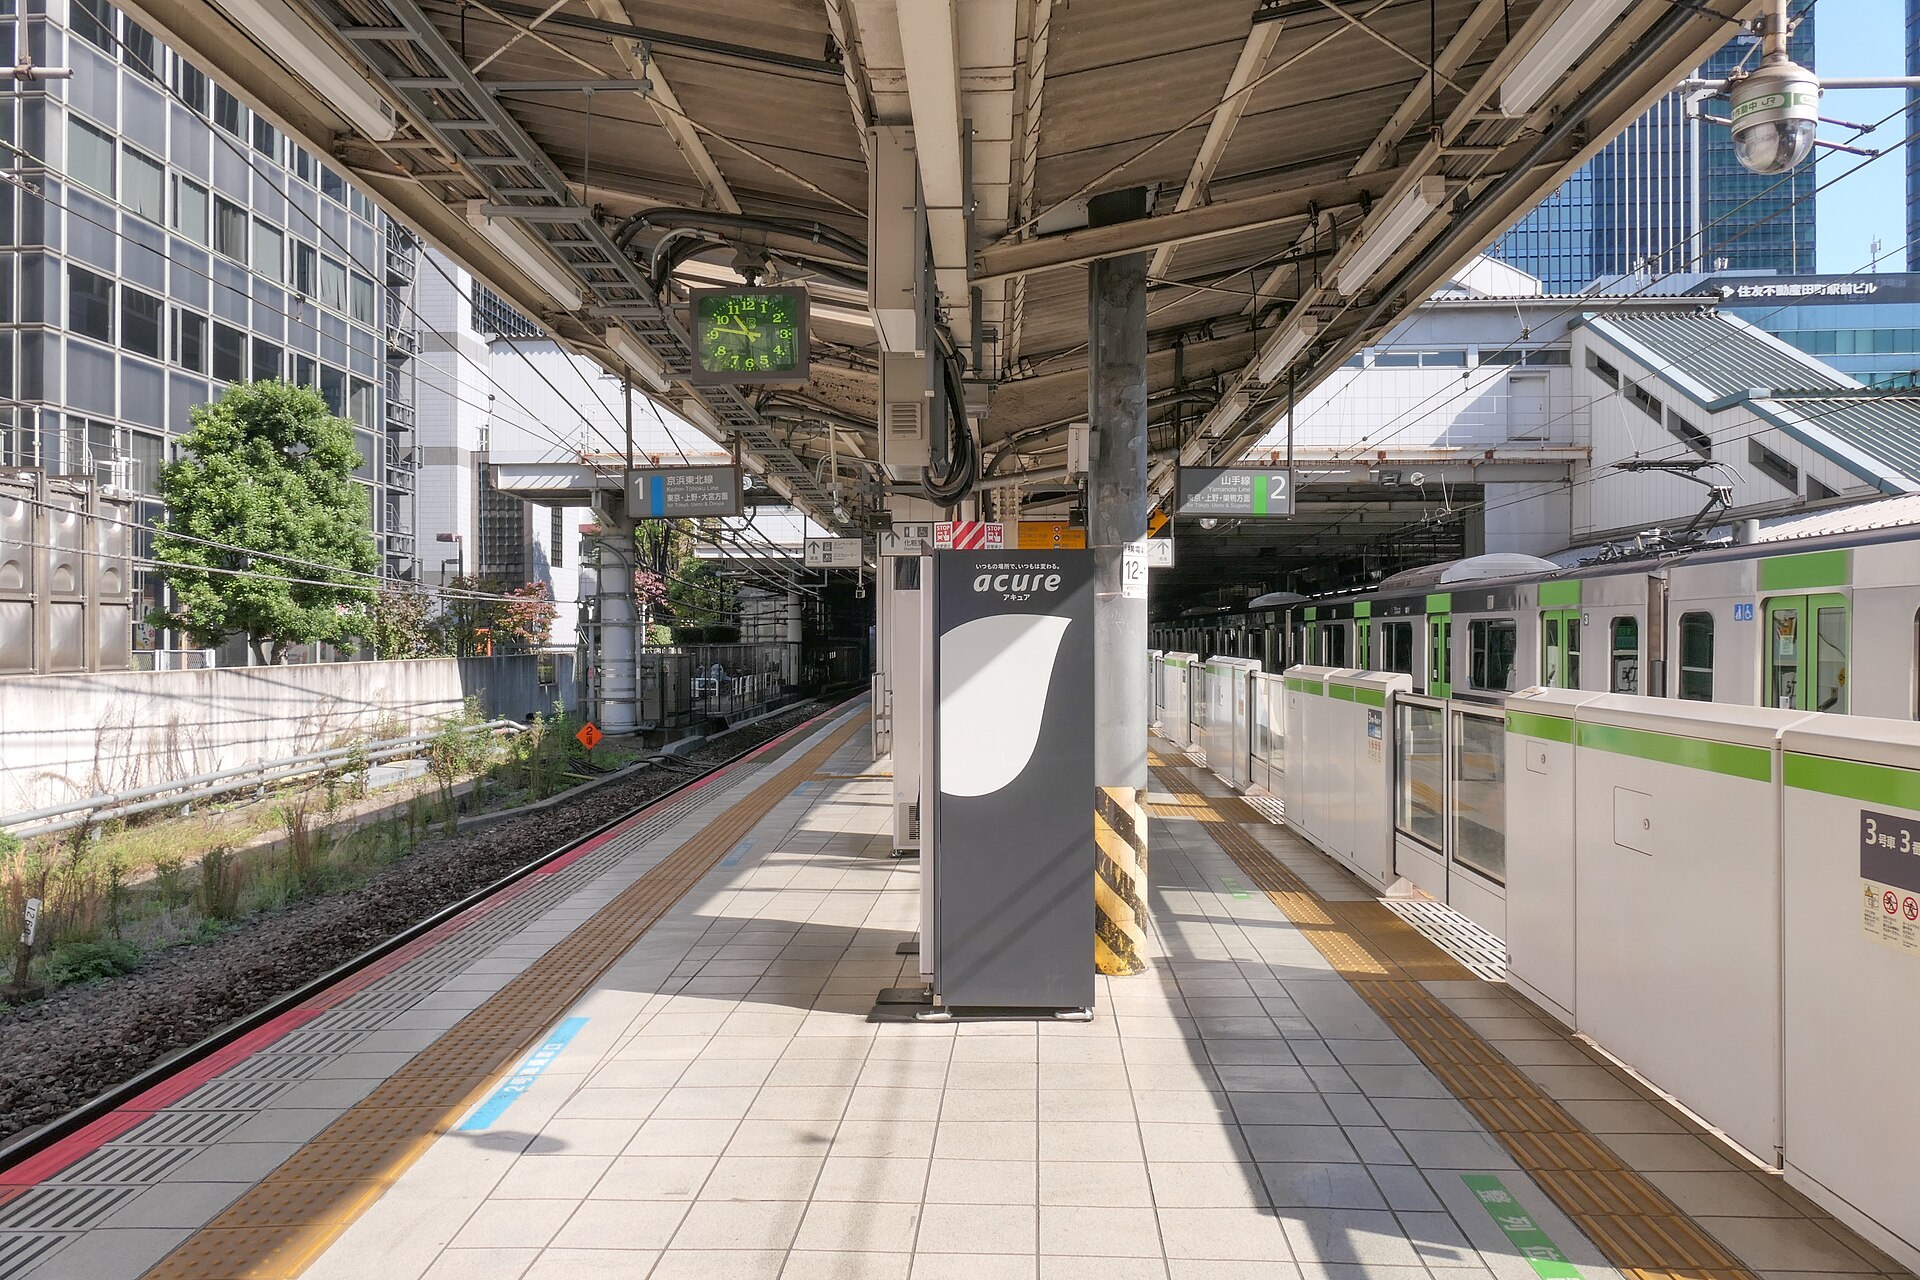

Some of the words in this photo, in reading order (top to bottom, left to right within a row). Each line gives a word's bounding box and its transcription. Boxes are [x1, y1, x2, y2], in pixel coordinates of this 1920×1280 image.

[1761, 96, 1776, 106] JR
[1737, 282, 1877, 298] 住友不動産田町駅前ビル
[728, 305, 740, 315] 11
[741, 300, 756, 311] 12
[760, 303, 767, 314] 1
[716, 315, 730, 325] 10
[772, 313, 782, 323] 2
[709, 330, 719, 340] 9
[779, 329, 789, 339] 3
[717, 345, 727, 356] 8
[772, 345, 782, 355] 4
[730, 355, 740, 366] 7
[745, 358, 754, 368] 6
[759, 355, 769, 365] 5
[666, 475, 714, 486] 京浜東北線
[1221, 475, 1251, 486] 山手線
[634, 477, 644, 500] 1
[1270, 475, 1286, 500] 2
[667, 492, 729, 502] 東京・上野・大宮方面
[973, 574, 1061, 592] acure
[586, 726, 593, 736] 2
[1865, 818, 1896, 849] 3号車
